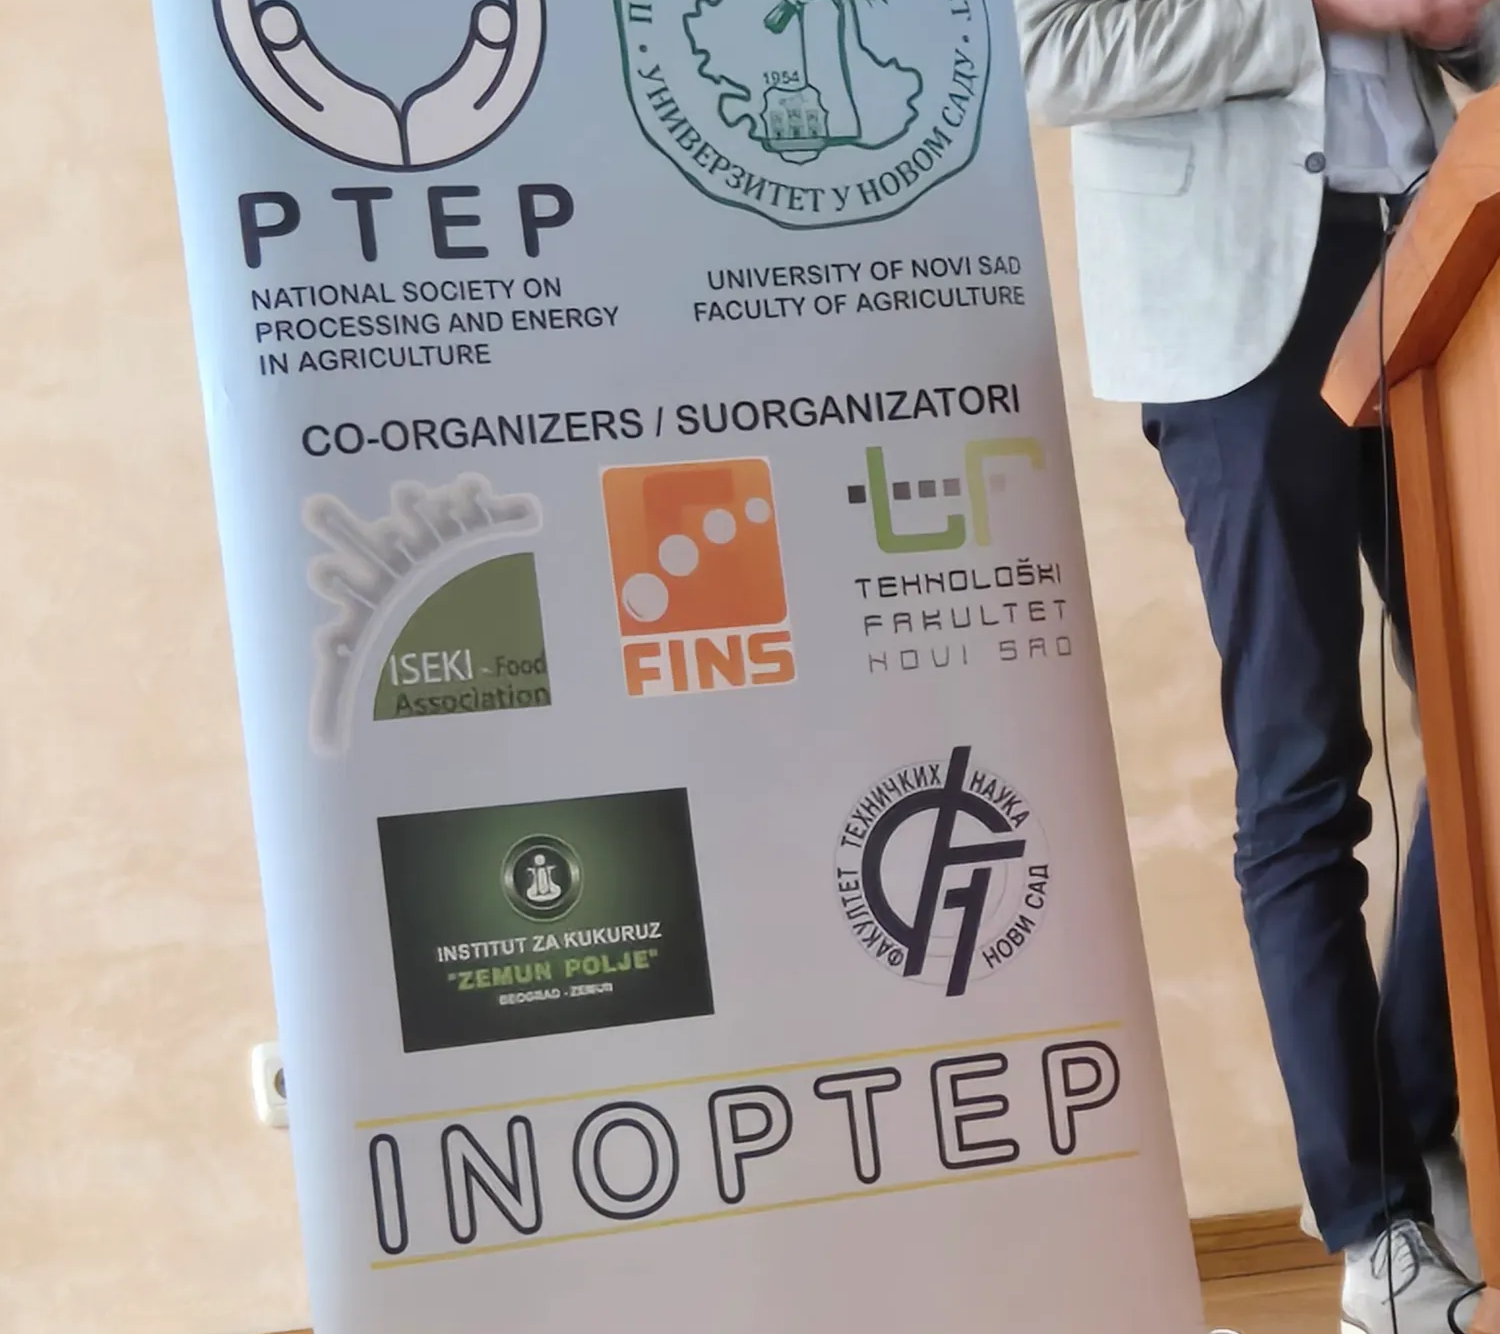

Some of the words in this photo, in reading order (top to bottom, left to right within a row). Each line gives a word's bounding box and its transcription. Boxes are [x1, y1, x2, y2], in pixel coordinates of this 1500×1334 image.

[638, 64, 825, 212] УНИВЕРЗИТЕТ
[834, 185, 852, 212] У
[858, 126, 953, 205] НОВОМ
[942, 48, 980, 129] САДУ
[238, 183, 574, 268] PTEP
[707, 263, 861, 290] UNIVERSITY
[870, 260, 903, 281] OF
[912, 257, 971, 278] NOVI
[978, 256, 1021, 275] SAD
[252, 282, 395, 310] NATIONAL
[403, 279, 515, 303] SOCIETY
[523, 277, 561, 298] ON
[694, 296, 805, 322] FACULTY
[814, 294, 847, 316] OF
[856, 286, 1025, 313] AGRICULTURE
[256, 312, 440, 343] PROCESSING
[449, 311, 503, 333] AND
[513, 306, 619, 330] ENERGY
[260, 353, 288, 375] IN
[298, 344, 491, 373] AGRICULTURE
[302, 408, 643, 456] CO-ORGANIZERS
[676, 384, 1020, 435] SUORGANIZATORI
[855, 558, 1062, 599] TEHNOLOŠKI
[864, 599, 1068, 637] FAKULTET
[388, 648, 473, 686] ISEKI
[495, 649, 547, 678] Food
[622, 630, 796, 697] FINS
[869, 648, 968, 674] NOVI
[999, 636, 1073, 663] SAD
[395, 685, 552, 715] Association
[840, 764, 942, 848] ТЕХНИЧКИХ
[969, 770, 1030, 829] НАУКА
[837, 867, 905, 967] ФАКУЛТЕТ
[982, 914, 1036, 968] НОВИ
[1025, 864, 1049, 909] САД
[438, 937, 527, 962] INSTITUT
[532, 934, 559, 953] ZA
[564, 922, 662, 948] KUKURUZ
[370, 1040, 1120, 1254] INOPTEP
